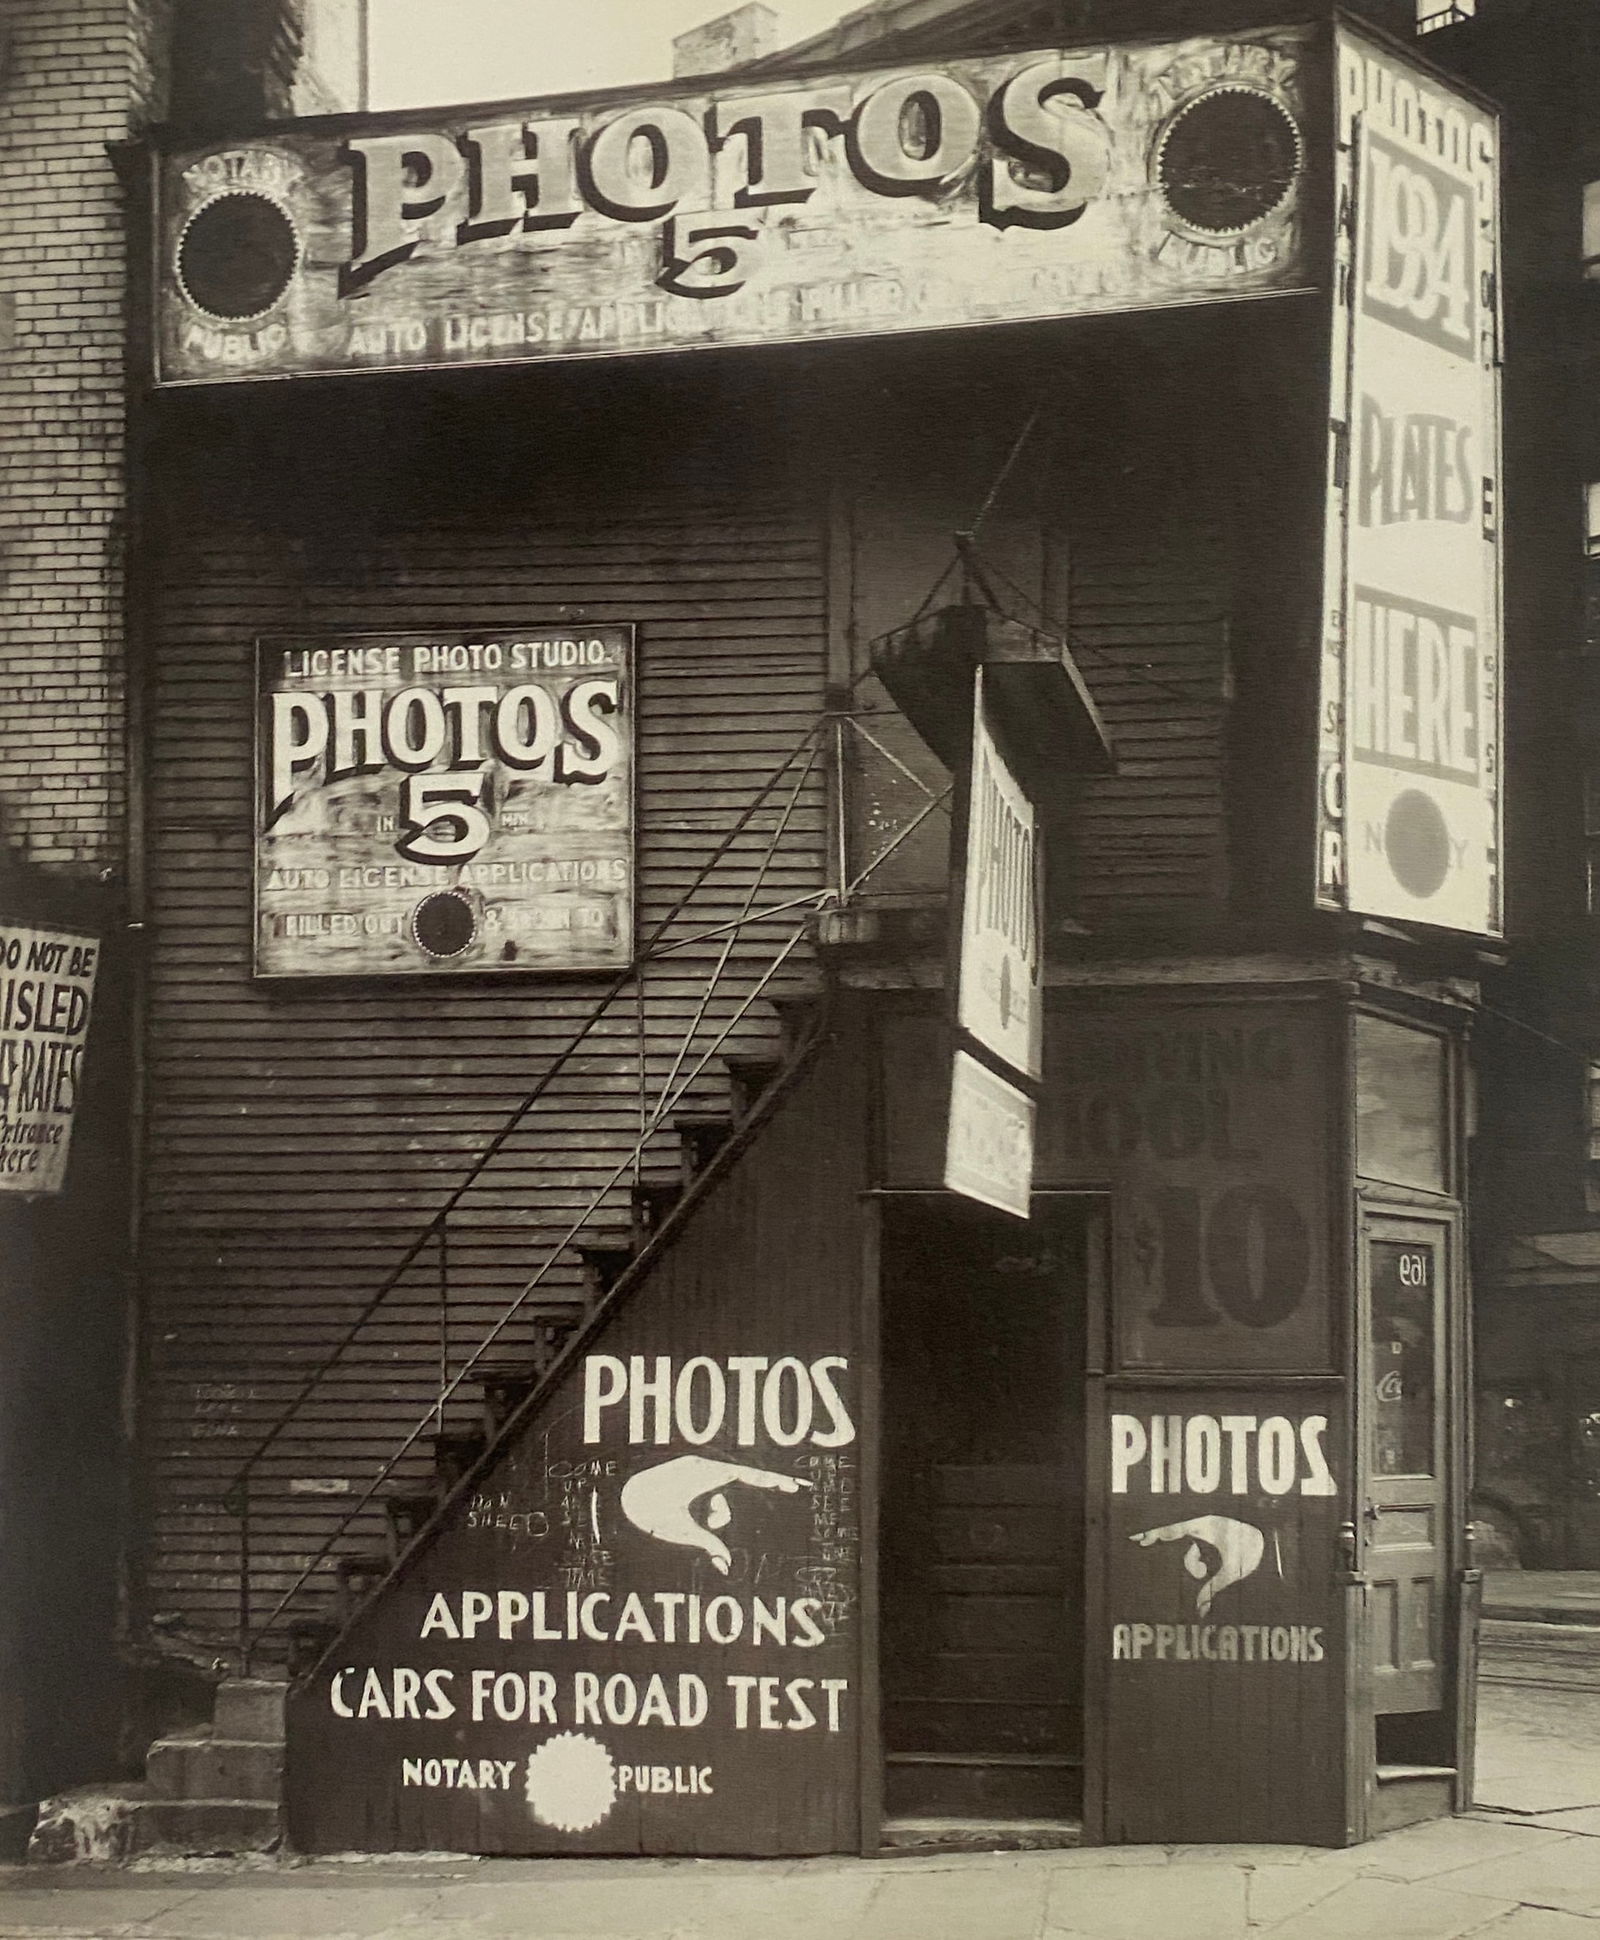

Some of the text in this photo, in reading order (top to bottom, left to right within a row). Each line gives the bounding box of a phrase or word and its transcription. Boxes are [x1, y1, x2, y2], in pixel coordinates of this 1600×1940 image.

[338, 52, 1112, 300] PHOTOS
[655, 210, 759, 300] 5
[1358, 391, 1474, 529] PLATES
[283, 646, 400, 677] LICENSE
[413, 643, 501, 672] PHOTO
[1353, 600, 1476, 775] HERE
[265, 679, 620, 831] PHOTOS
[394, 772, 491, 866] 5
[264, 859, 628, 891] AUTO LICENSE APPLICATIONS
[26, 941, 69, 974] NOT
[69, 946, 96, 977] BE
[0, 978, 88, 1036] ISLED
[583, 1355, 856, 1448] PHOTOS
[1111, 1414, 1337, 1496] PHOTOS
[419, 1591, 827, 1647] APPLICATIONS
[1112, 1623, 1325, 1663] APPLICATIONS
[329, 1667, 849, 1733] CARS FOR ROAD TEST
[403, 1758, 714, 1795] NOTARY PUBLIC
